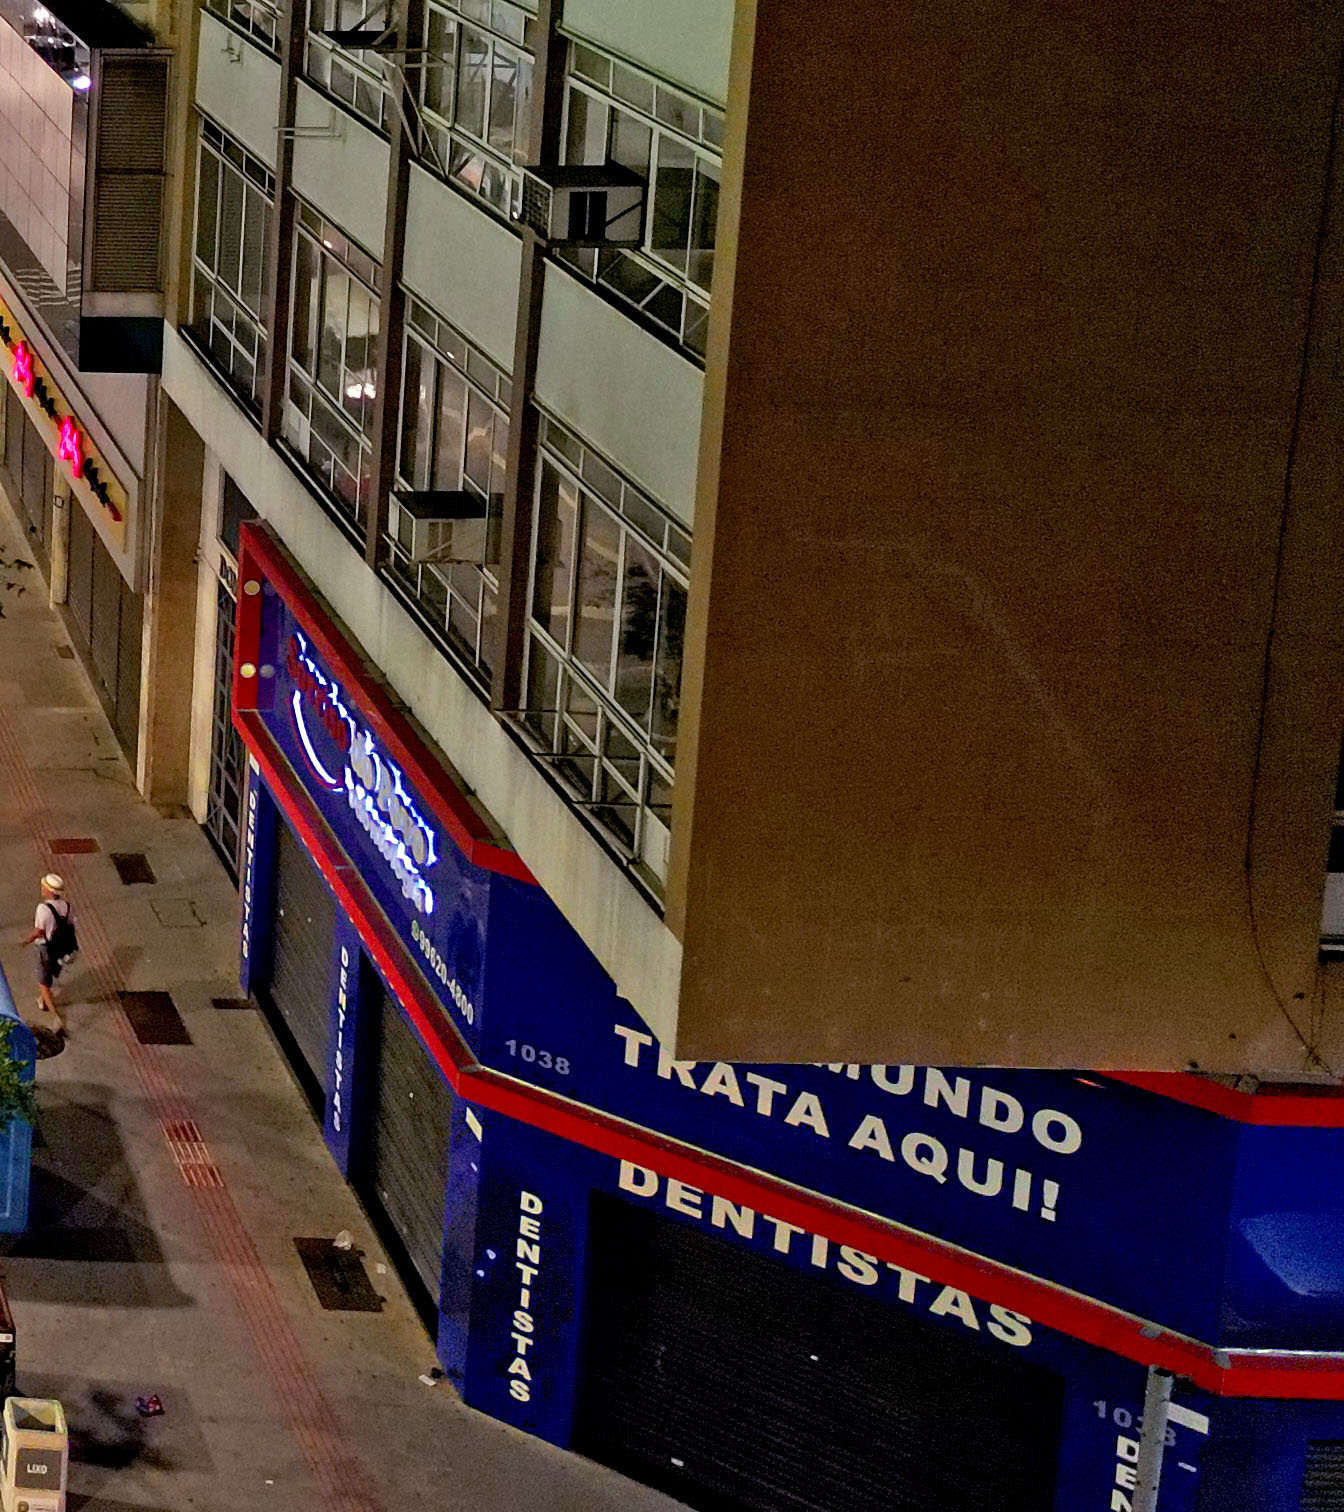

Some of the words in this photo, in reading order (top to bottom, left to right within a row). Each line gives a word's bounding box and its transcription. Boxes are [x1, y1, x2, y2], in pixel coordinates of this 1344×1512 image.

[505, 1039, 571, 1076] 1038
[614, 1024, 830, 1138] TRATA
[848, 1114, 1060, 1222] AQUI!
[508, 1191, 543, 1402] DENTISTAS
[618, 1159, 1033, 1347] DENTISTAS
[27, 1463, 48, 1474] LIXO
[1093, 1399, 1177, 1447] 108
